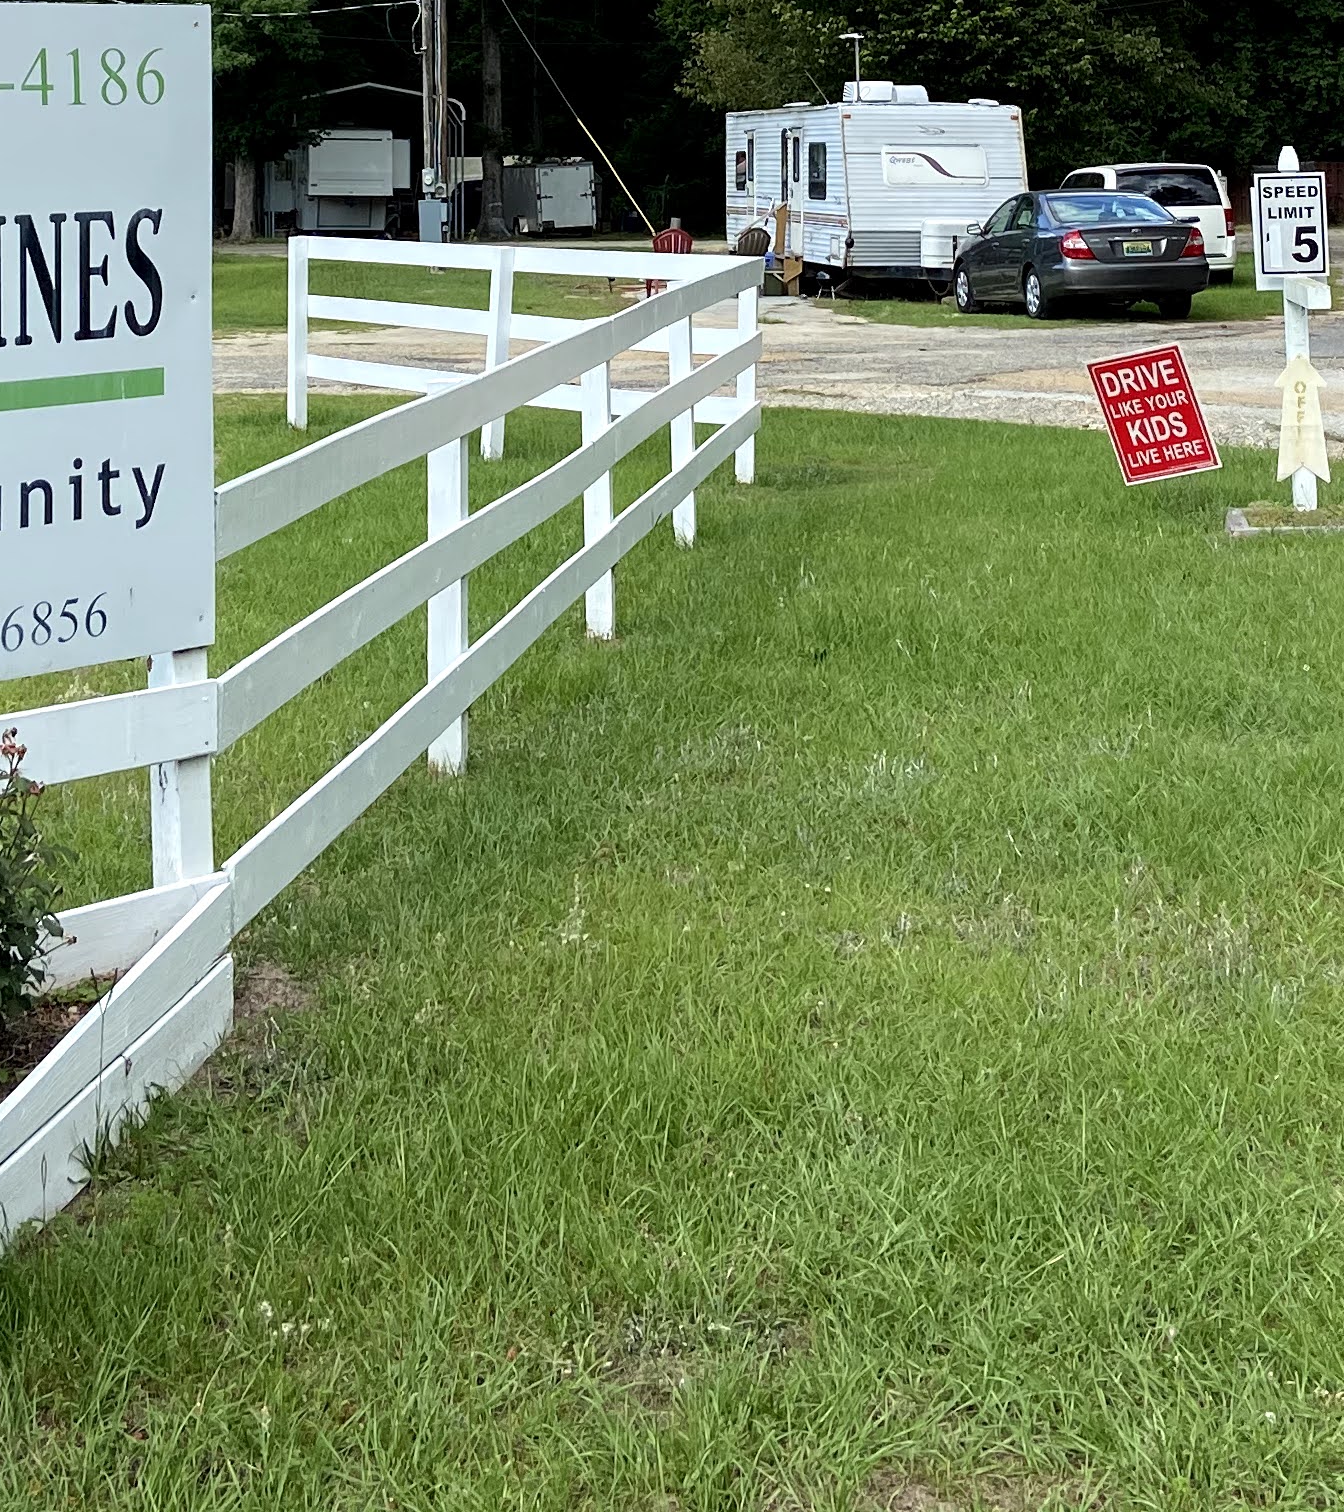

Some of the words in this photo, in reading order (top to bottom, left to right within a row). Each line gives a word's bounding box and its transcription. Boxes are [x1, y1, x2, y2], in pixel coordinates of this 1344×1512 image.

[1262, 185, 1319, 199] SPEED
[1267, 206, 1315, 220] LIMIT
[1099, 358, 1180, 398] DRIVE
[1109, 398, 1145, 419] LIKE
[1144, 389, 1189, 412] YOUR
[1125, 411, 1188, 447] KIDS
[1127, 447, 1162, 468] LIVE
[1162, 439, 1206, 462] HERE
